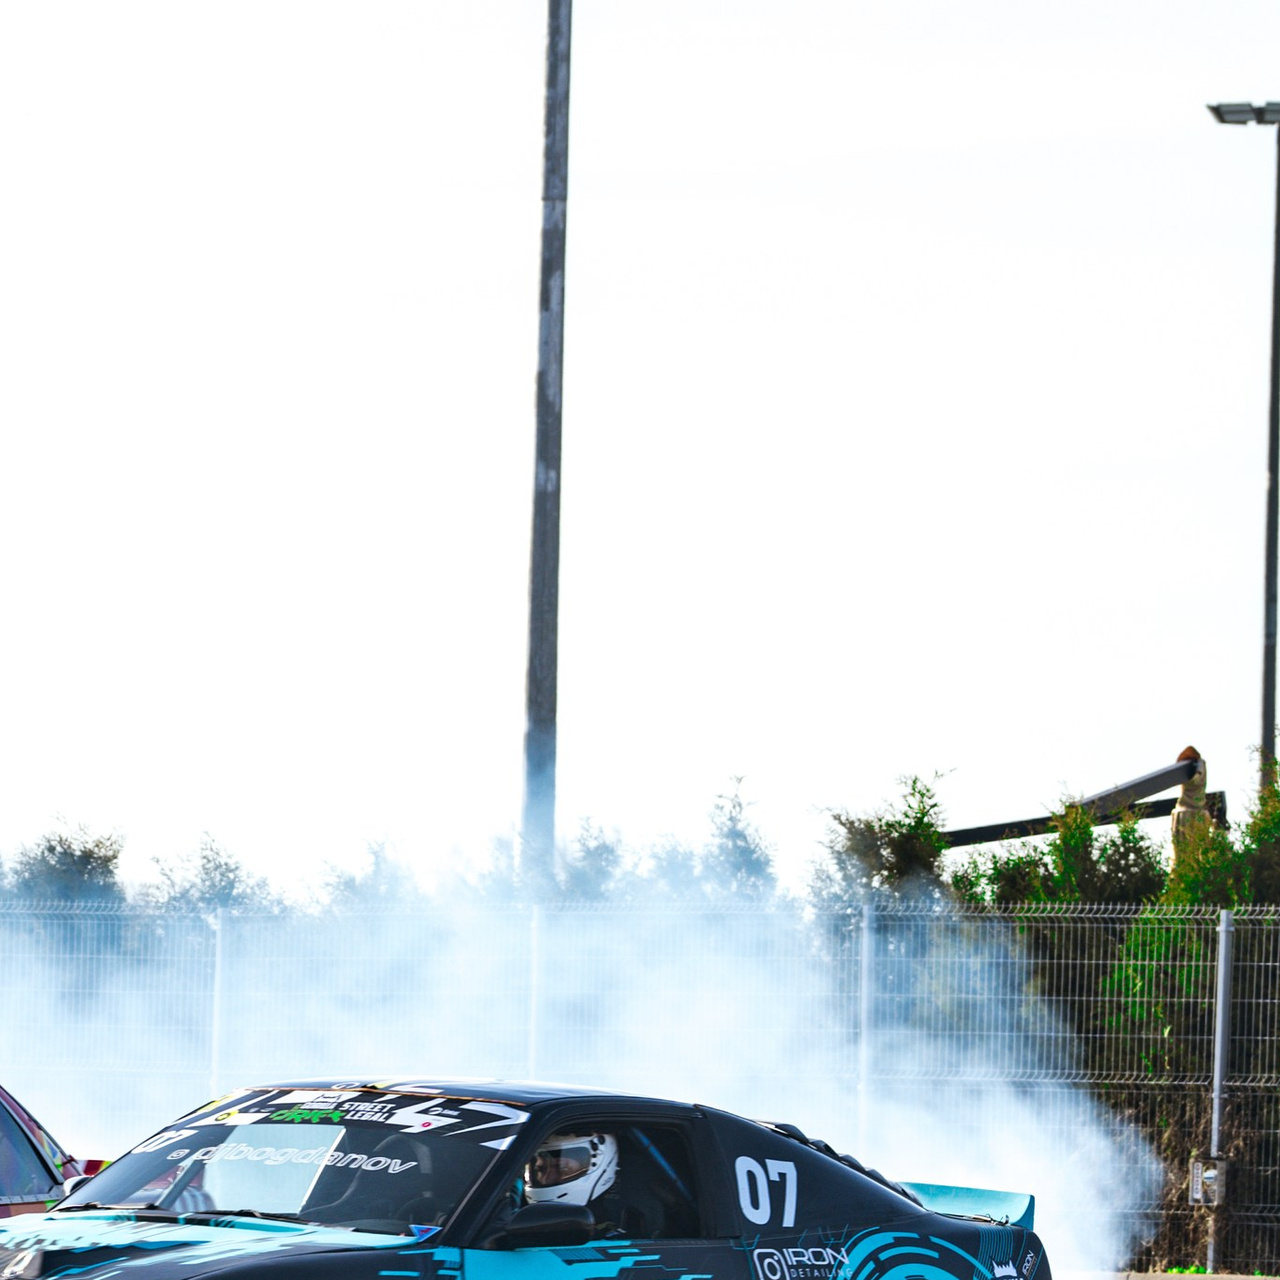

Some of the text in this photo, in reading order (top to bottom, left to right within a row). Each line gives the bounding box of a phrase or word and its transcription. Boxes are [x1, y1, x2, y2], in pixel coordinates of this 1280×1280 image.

[339, 1101, 397, 1113] STREET
[343, 1110, 392, 1122] LEGAL
[131, 1129, 199, 1155] 07
[192, 1142, 418, 1174] djbogdanov
[734, 1155, 798, 1228] 07
[782, 1247, 850, 1266] IRON
[790, 1268, 853, 1278] DETAILING
